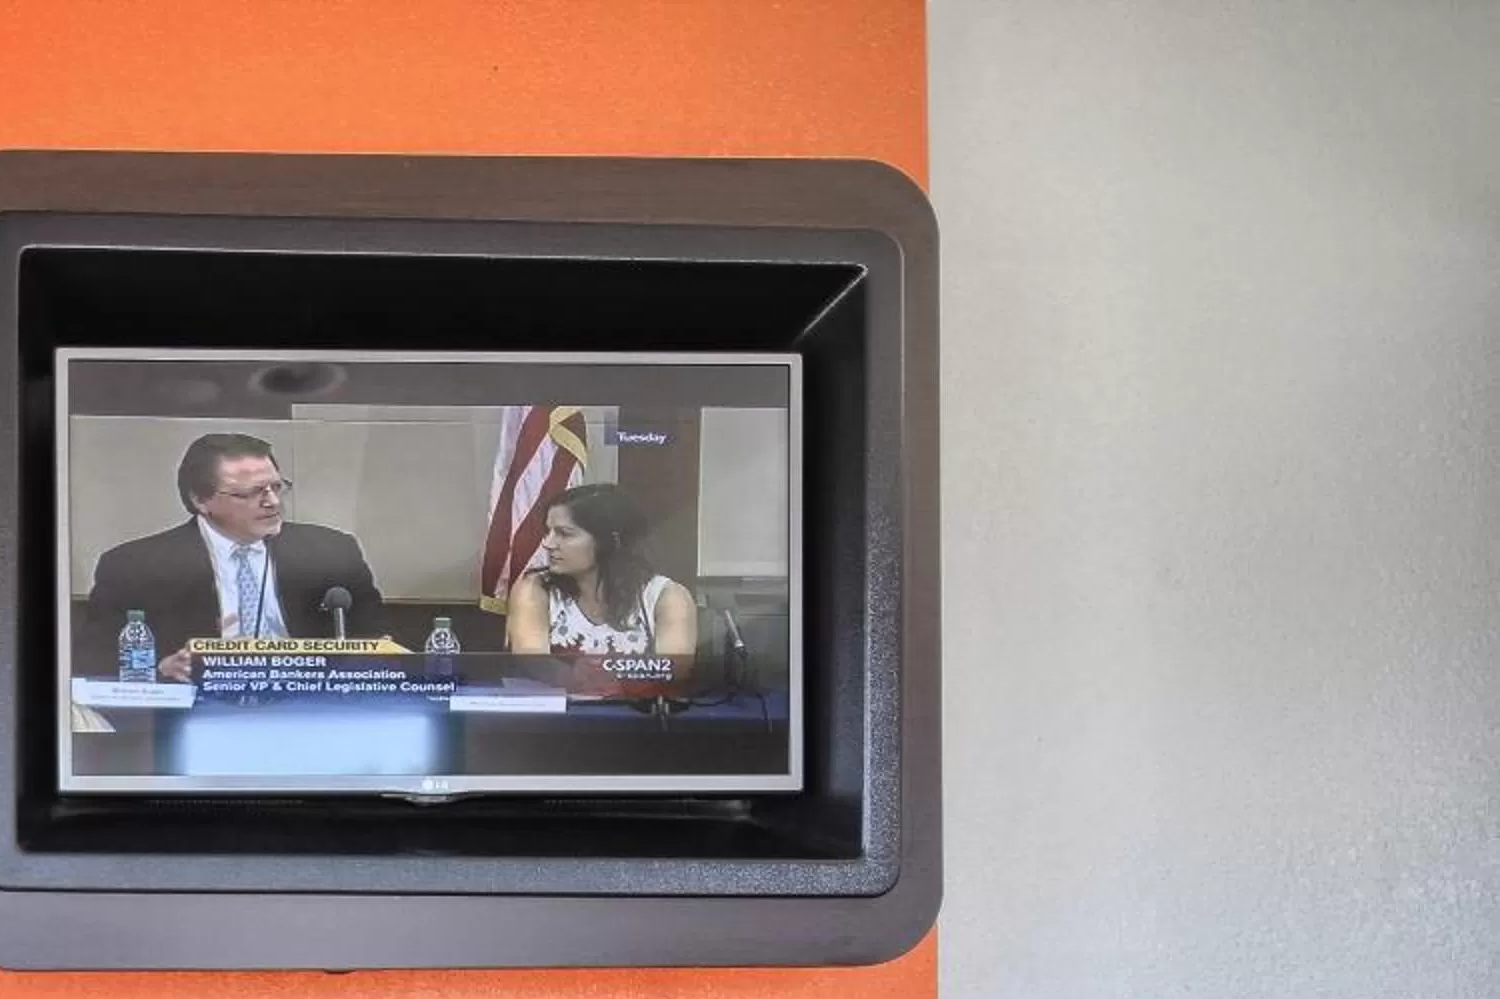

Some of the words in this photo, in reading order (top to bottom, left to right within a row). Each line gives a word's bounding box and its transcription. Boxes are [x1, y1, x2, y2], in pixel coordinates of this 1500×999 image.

[193, 640, 249, 651] CREDIT
[255, 640, 299, 651] CARD
[303, 640, 379, 651] SECURITY
[202, 656, 267, 667] WILLIAM
[202, 669, 267, 680] American
[269, 669, 325, 680] Bankers
[328, 669, 407, 680] Association
[202, 681, 246, 692] Senior
[250, 681, 268, 692] VP
[272, 681, 283, 692] &
[287, 681, 322, 692] Chief
[324, 681, 397, 694] Legislative
[399, 680, 456, 692] Counsel
